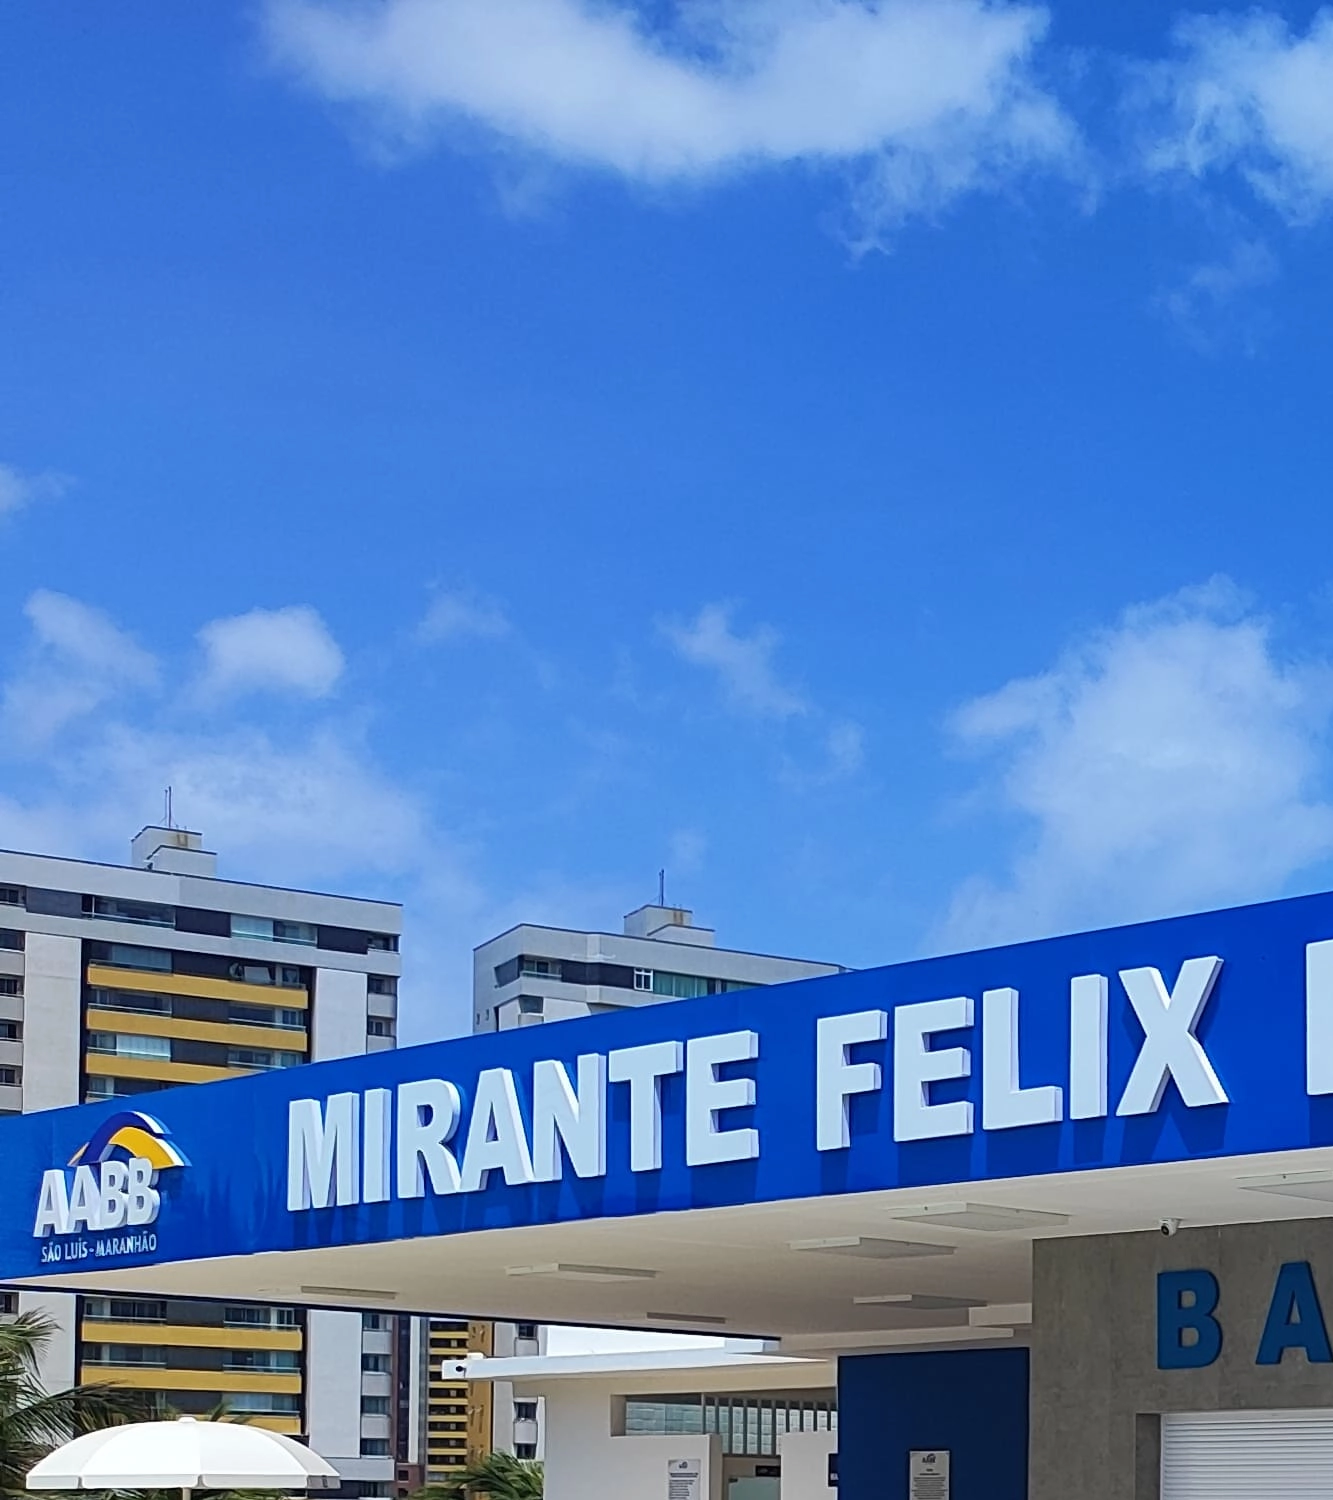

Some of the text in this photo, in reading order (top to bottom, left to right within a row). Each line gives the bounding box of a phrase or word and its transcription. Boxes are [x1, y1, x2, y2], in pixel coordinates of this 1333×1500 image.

[287, 1030, 760, 1212] MIRANTE
[816, 956, 1230, 1152] FELIX
[33, 1157, 160, 1238] AABB
[41, 1242, 61, 1262] SÃO
[64, 1238, 88, 1260] LUÍS
[95, 1231, 157, 1257] MARANHÃO
